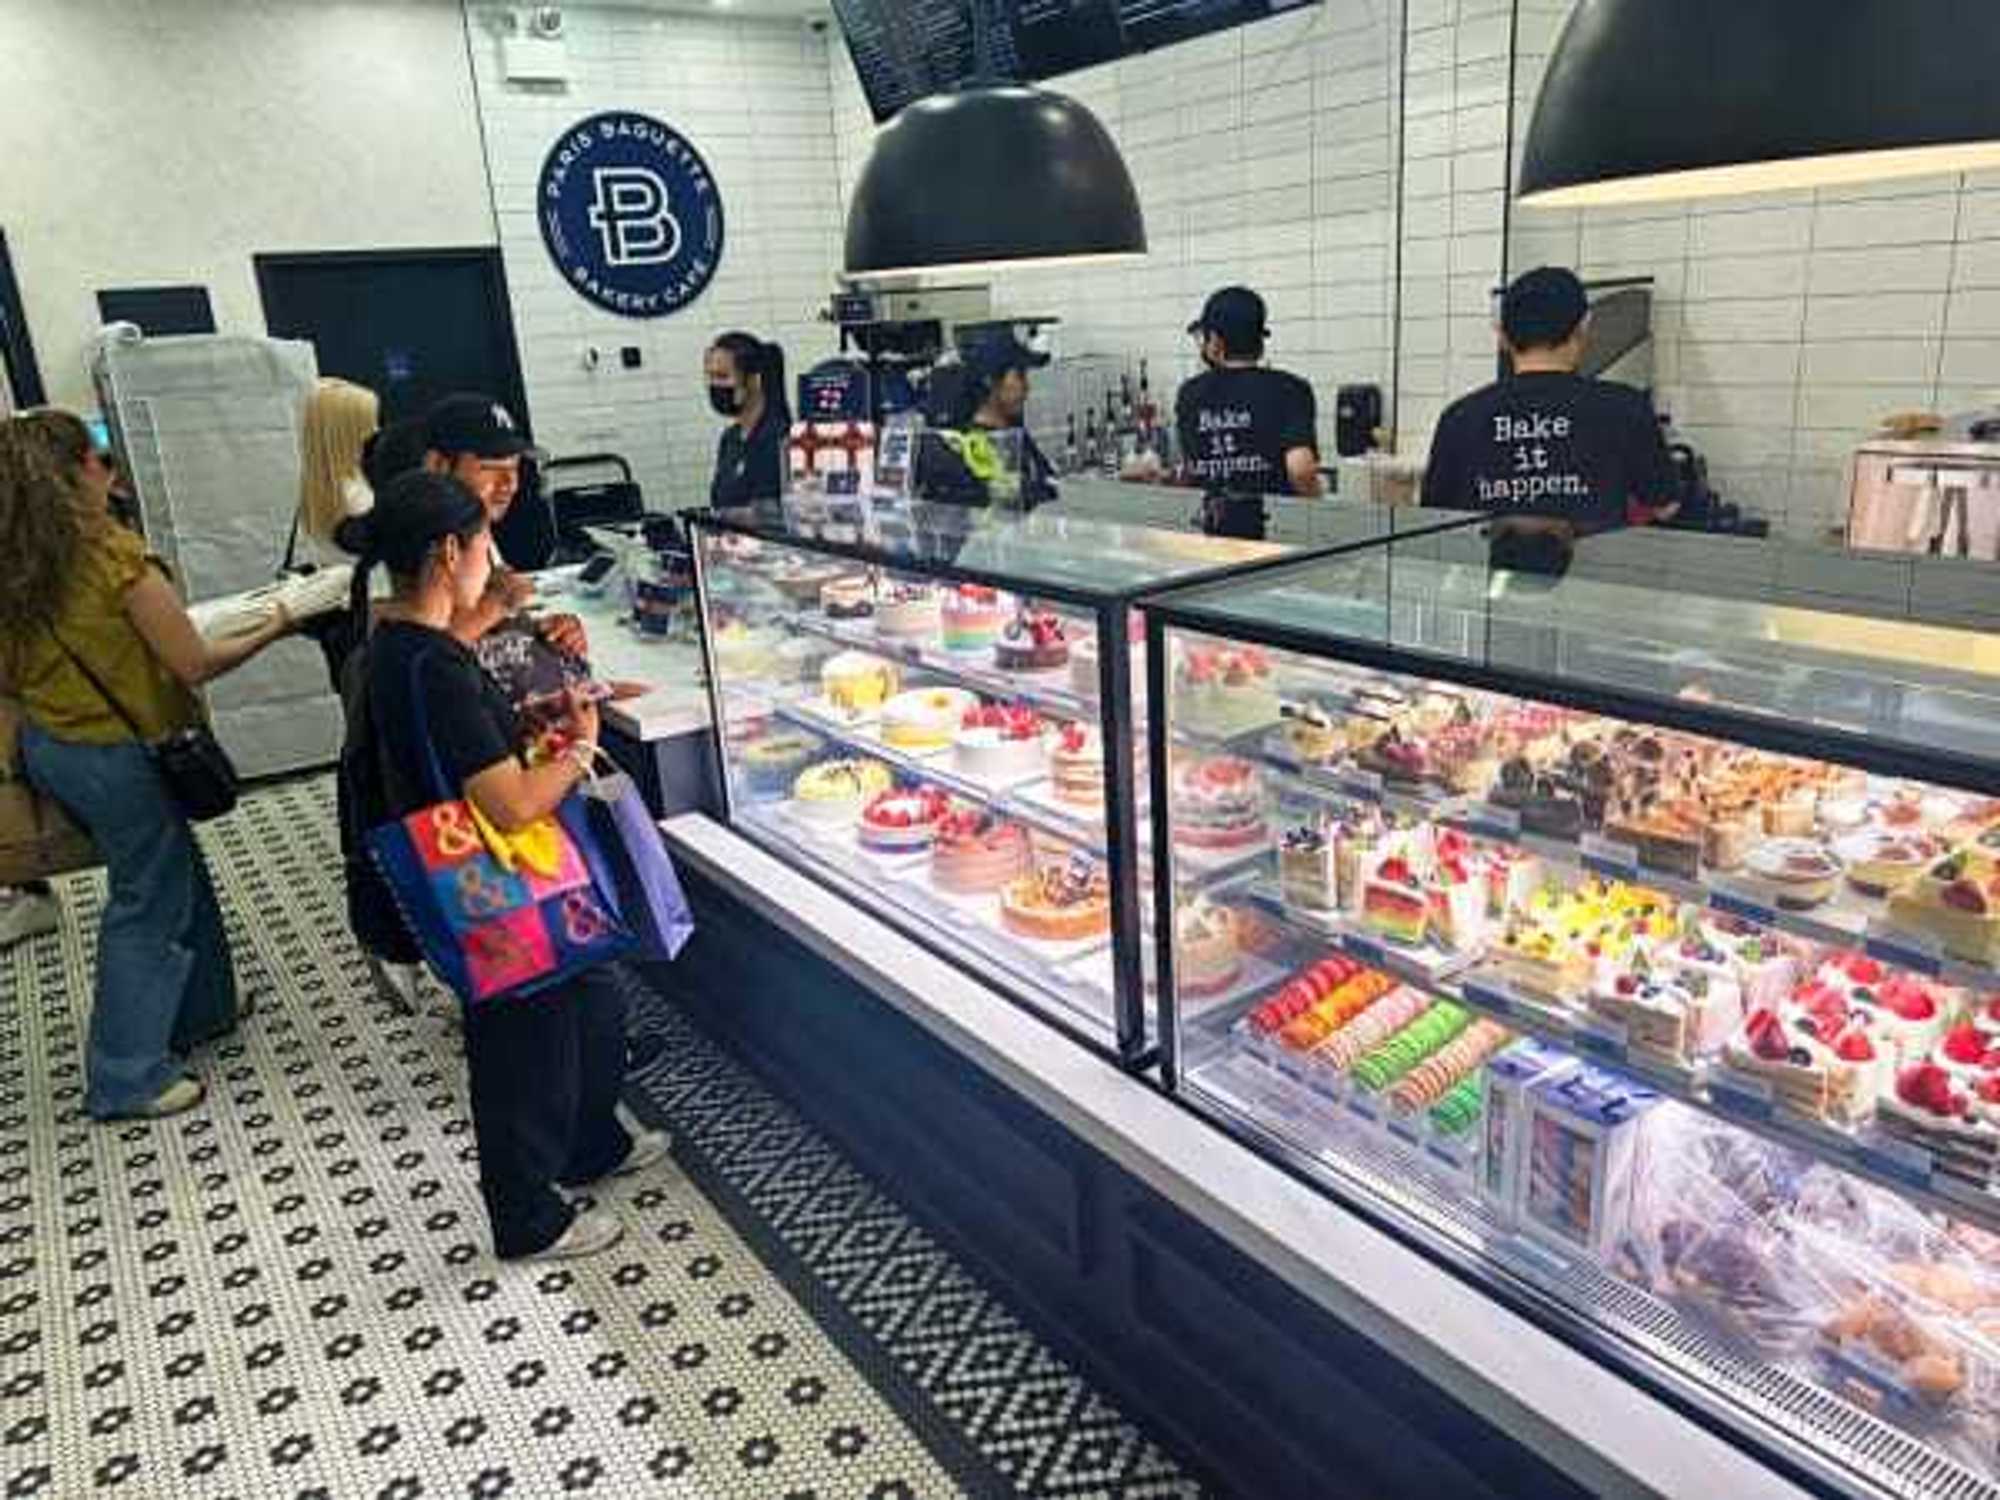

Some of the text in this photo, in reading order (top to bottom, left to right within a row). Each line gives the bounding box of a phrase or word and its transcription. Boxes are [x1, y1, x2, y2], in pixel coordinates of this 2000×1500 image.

[547, 119, 710, 198] PARIS BAGUETTE
[572, 265, 659, 309] BAKERY
[1199, 409, 1252, 432] Bake
[1493, 414, 1571, 441] Bake
[1211, 433, 1236, 455] it
[1515, 445, 1549, 471] it
[1478, 474, 1589, 502] happen.
